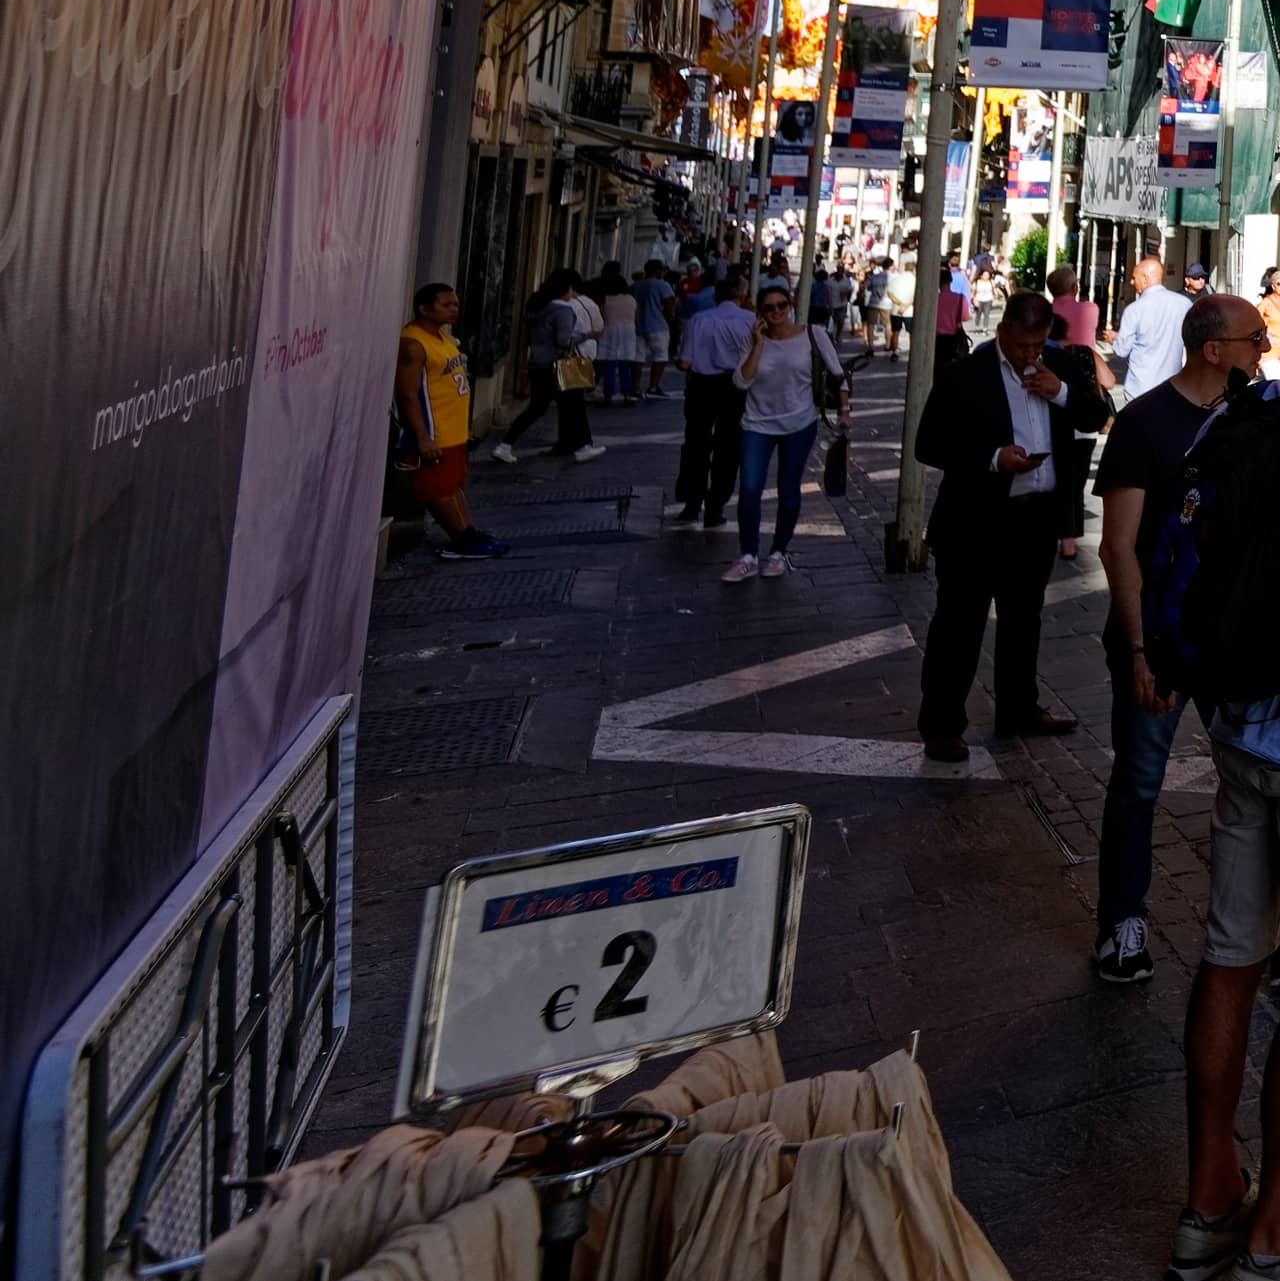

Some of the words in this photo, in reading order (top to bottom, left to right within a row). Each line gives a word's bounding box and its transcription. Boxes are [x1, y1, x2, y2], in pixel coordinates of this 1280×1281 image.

[1104, 156, 1135, 202] APS
[494, 888, 609, 928] Linen
[623, 874, 654, 901] &
[670, 864, 728, 893] Co.
[539, 983, 580, 1033] €
[593, 929, 658, 1023] 2
